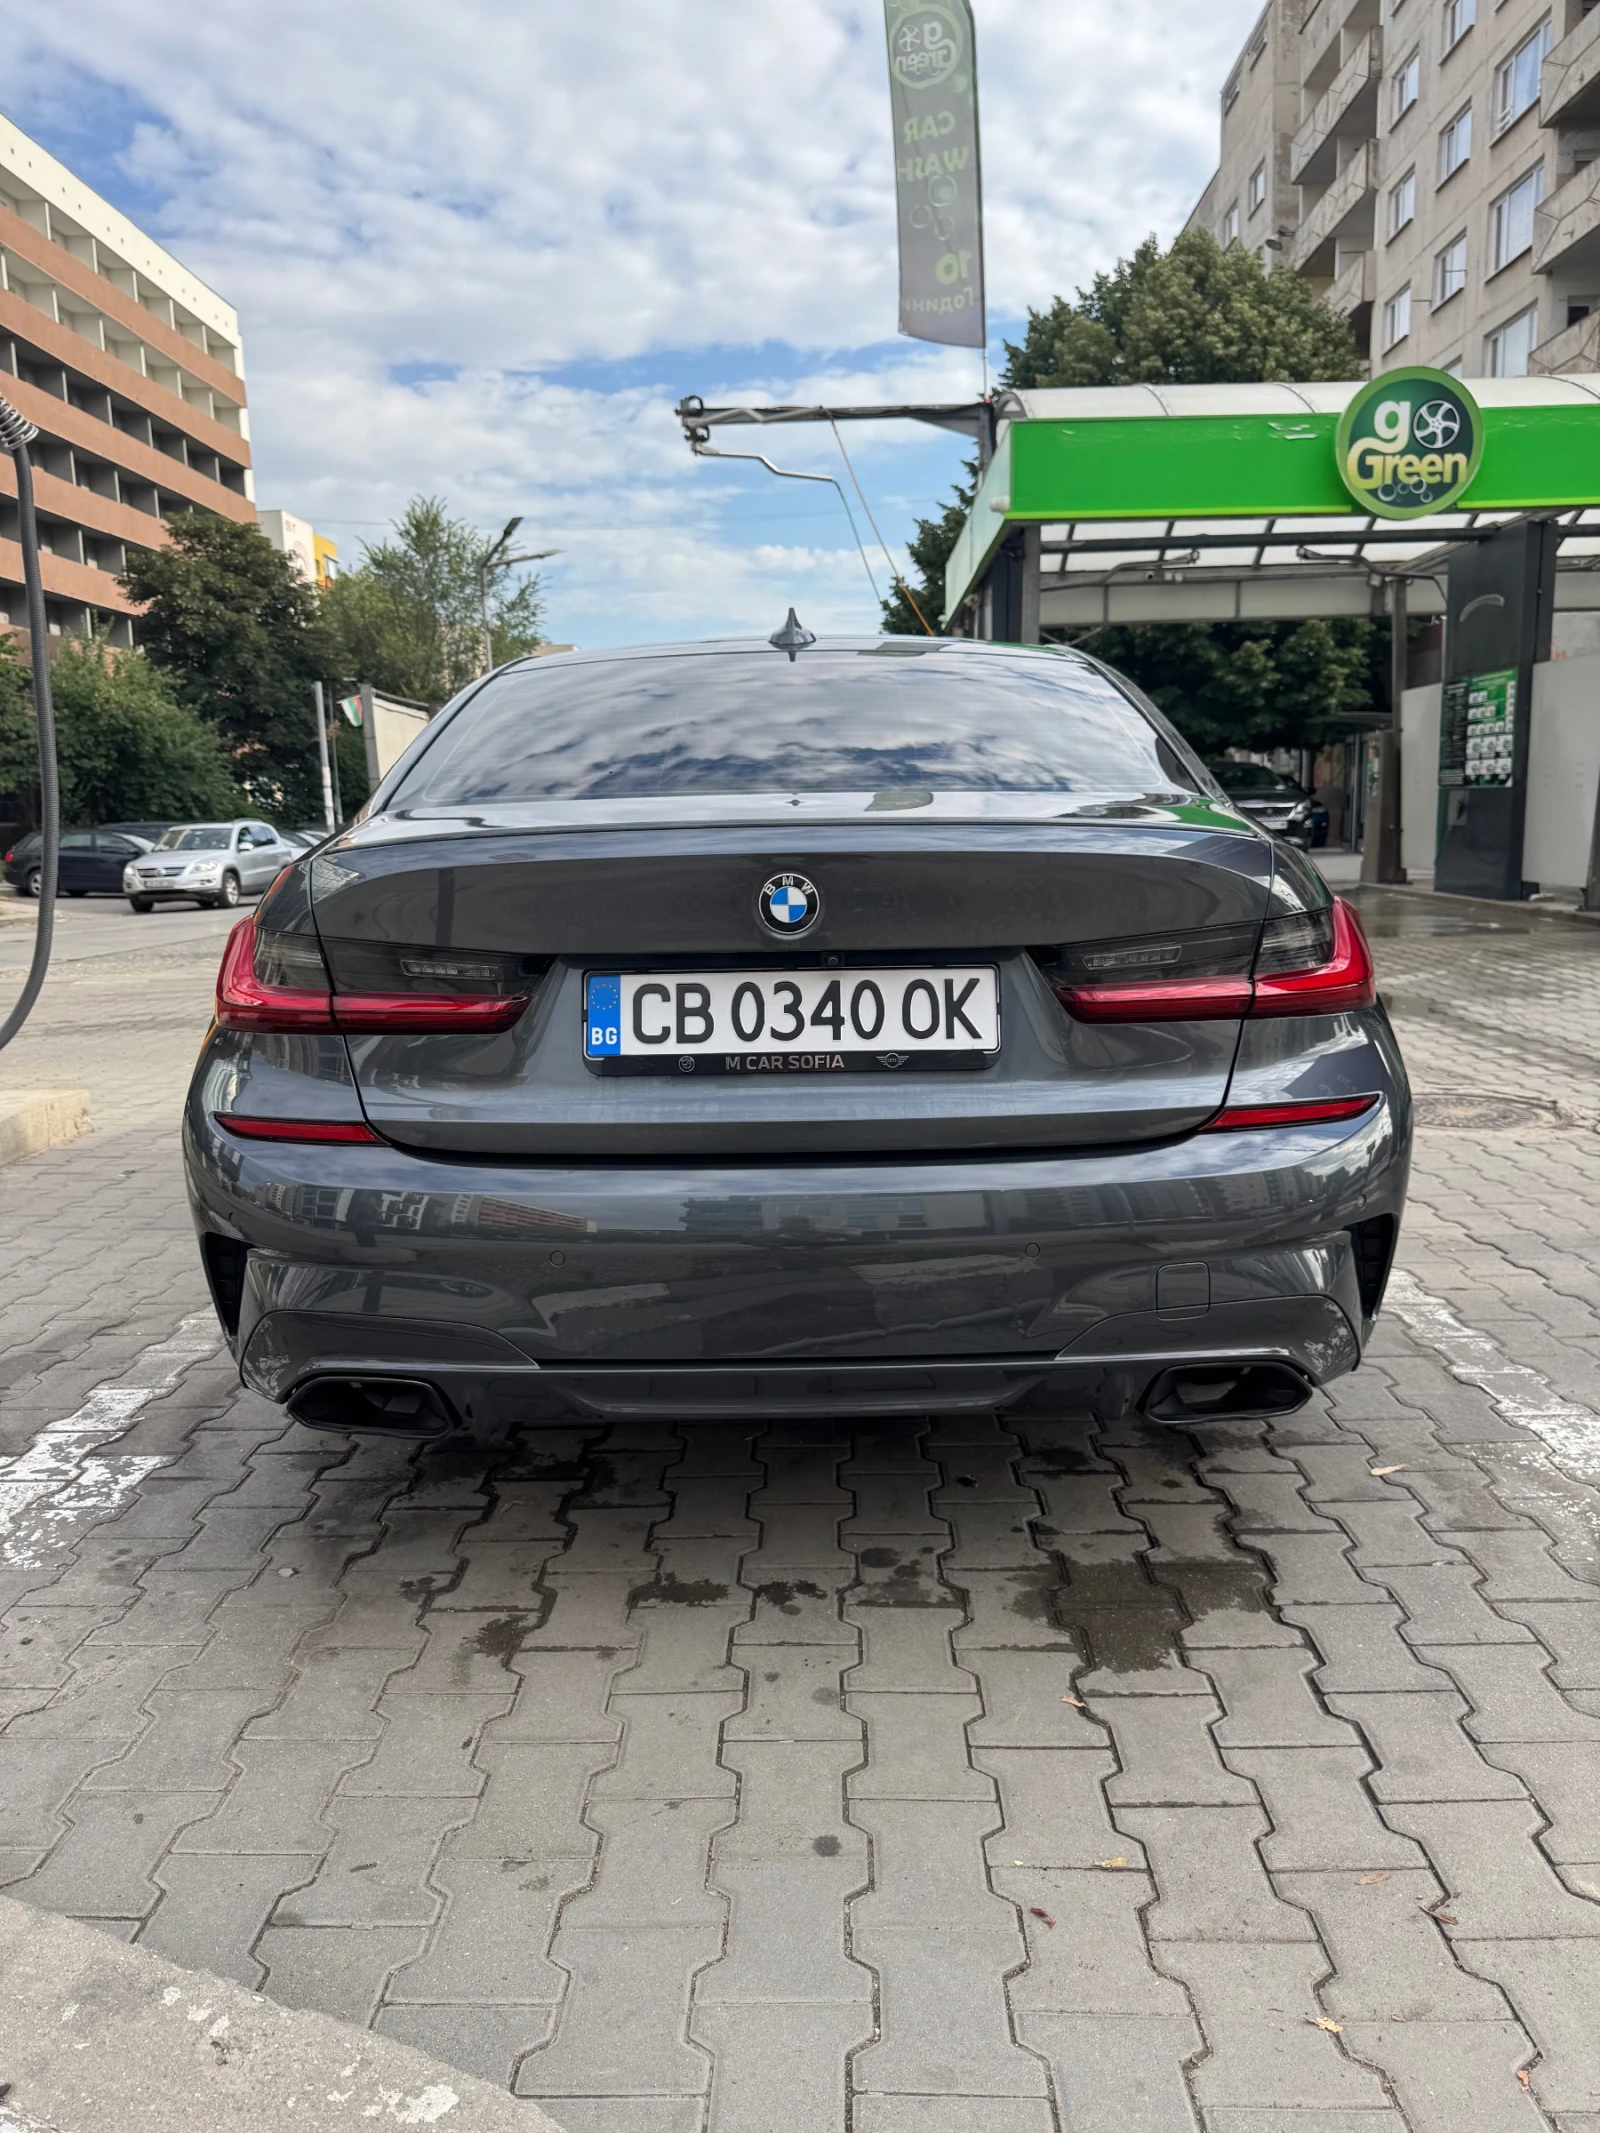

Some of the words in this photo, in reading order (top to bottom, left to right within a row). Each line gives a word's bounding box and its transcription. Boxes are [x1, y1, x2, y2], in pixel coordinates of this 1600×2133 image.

[1347, 437, 1467, 490] Green
[763, 876, 814, 897] BMW
[633, 983, 714, 1044] CB
[731, 979, 885, 1042] 0340
[901, 978, 982, 1040] OK
[591, 1027, 618, 1045] BG
[725, 1056, 741, 1070] M
[746, 1056, 784, 1070] CAR
[788, 1054, 845, 1070] SOFIA
